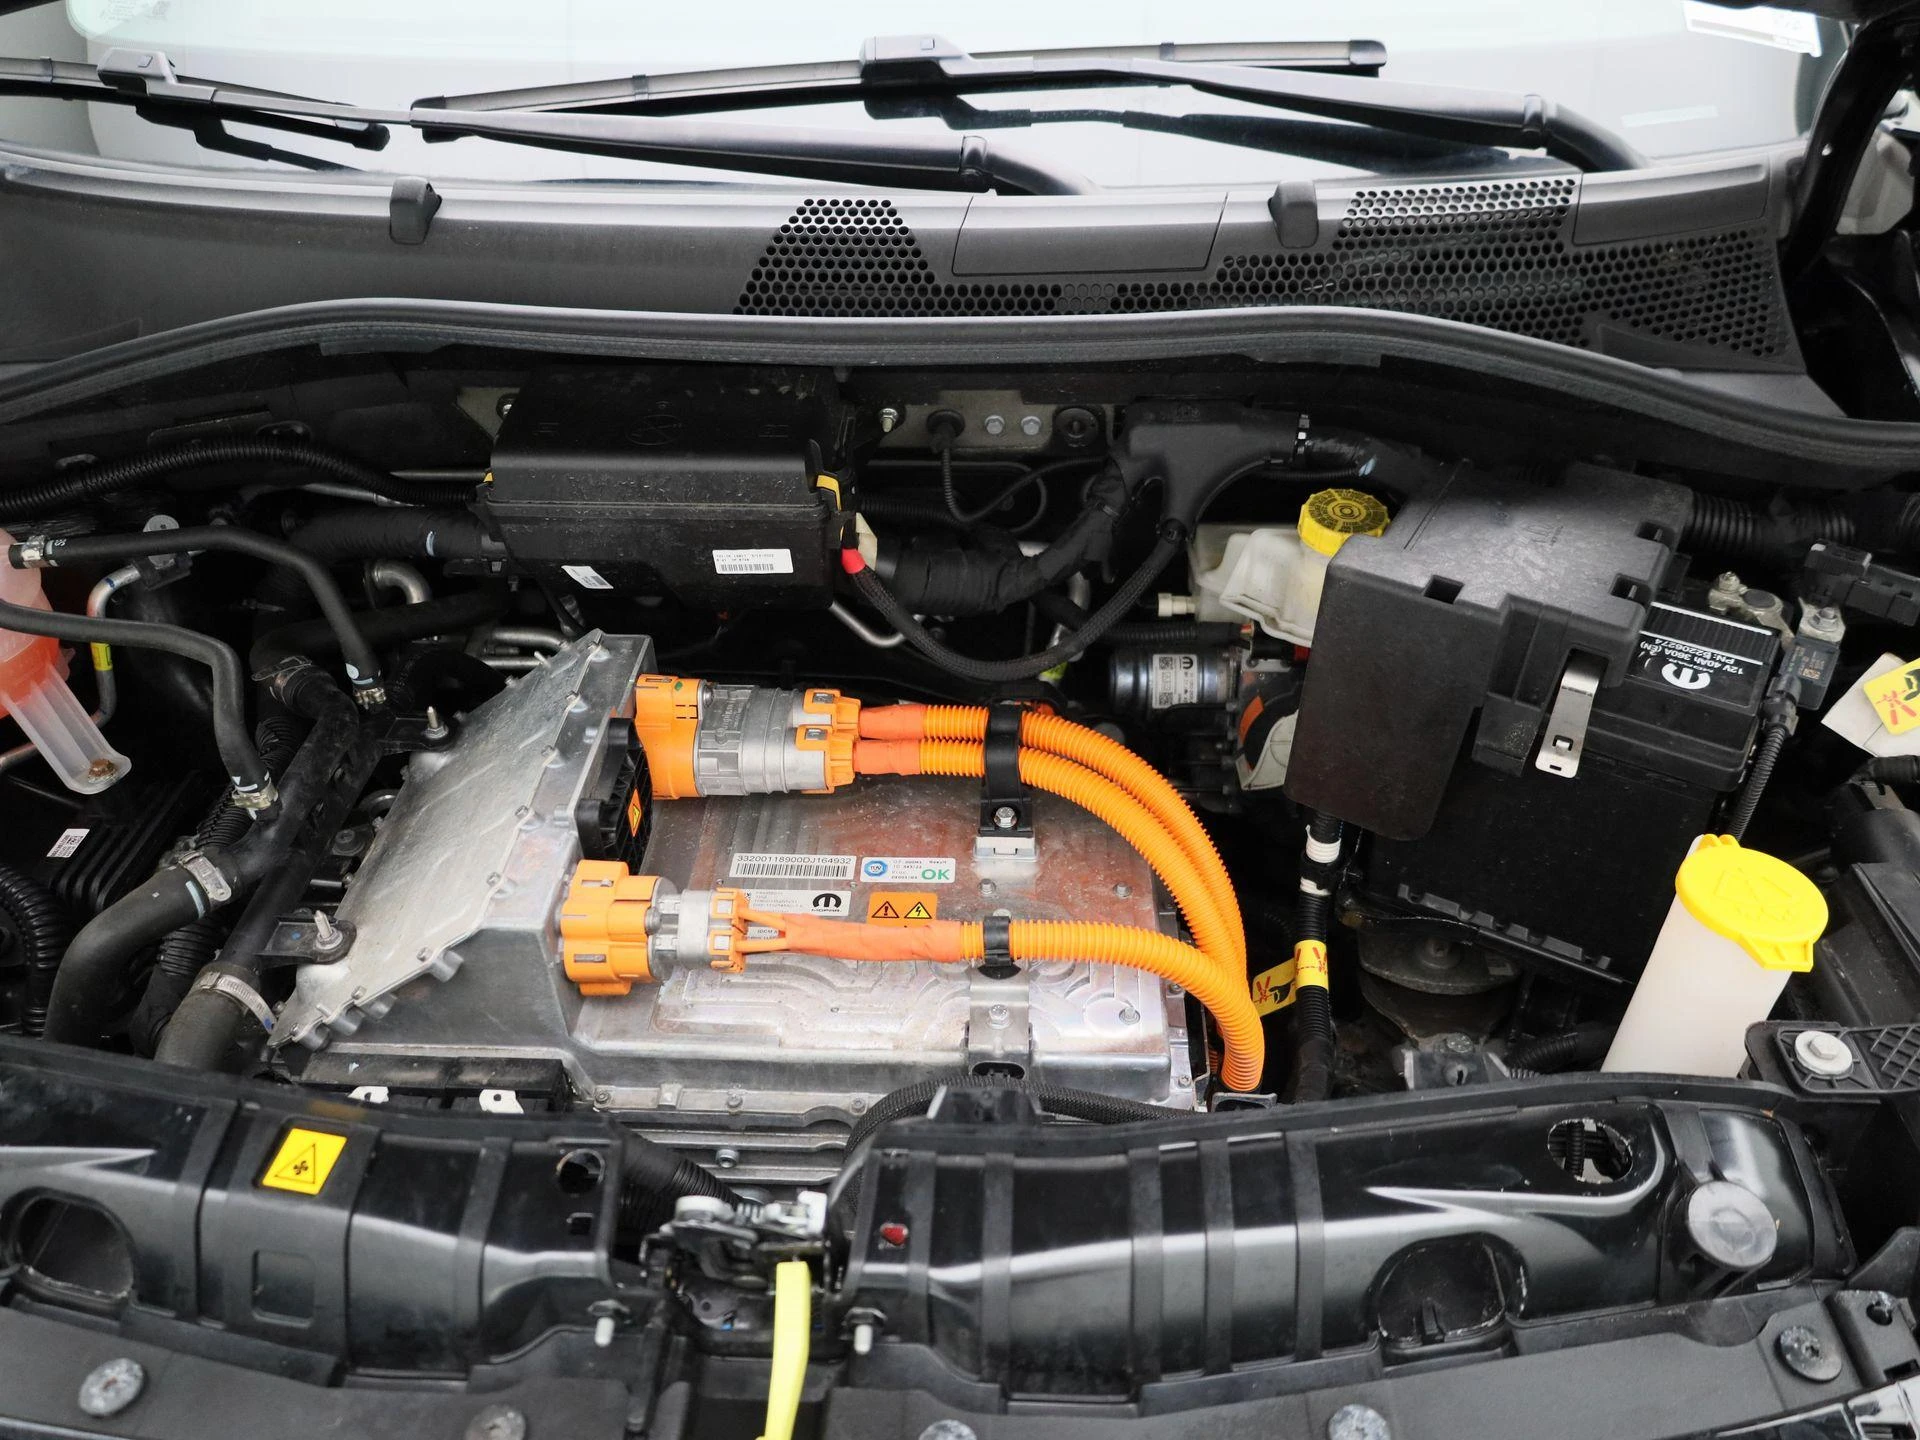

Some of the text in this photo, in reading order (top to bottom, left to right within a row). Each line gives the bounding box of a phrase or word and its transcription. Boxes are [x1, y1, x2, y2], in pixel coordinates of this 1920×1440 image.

[1640, 640, 1744, 675] 12V 40Ah 360A (EN)
[1713, 653, 1735, 665] PN:
[921, 869, 950, 880] OK
